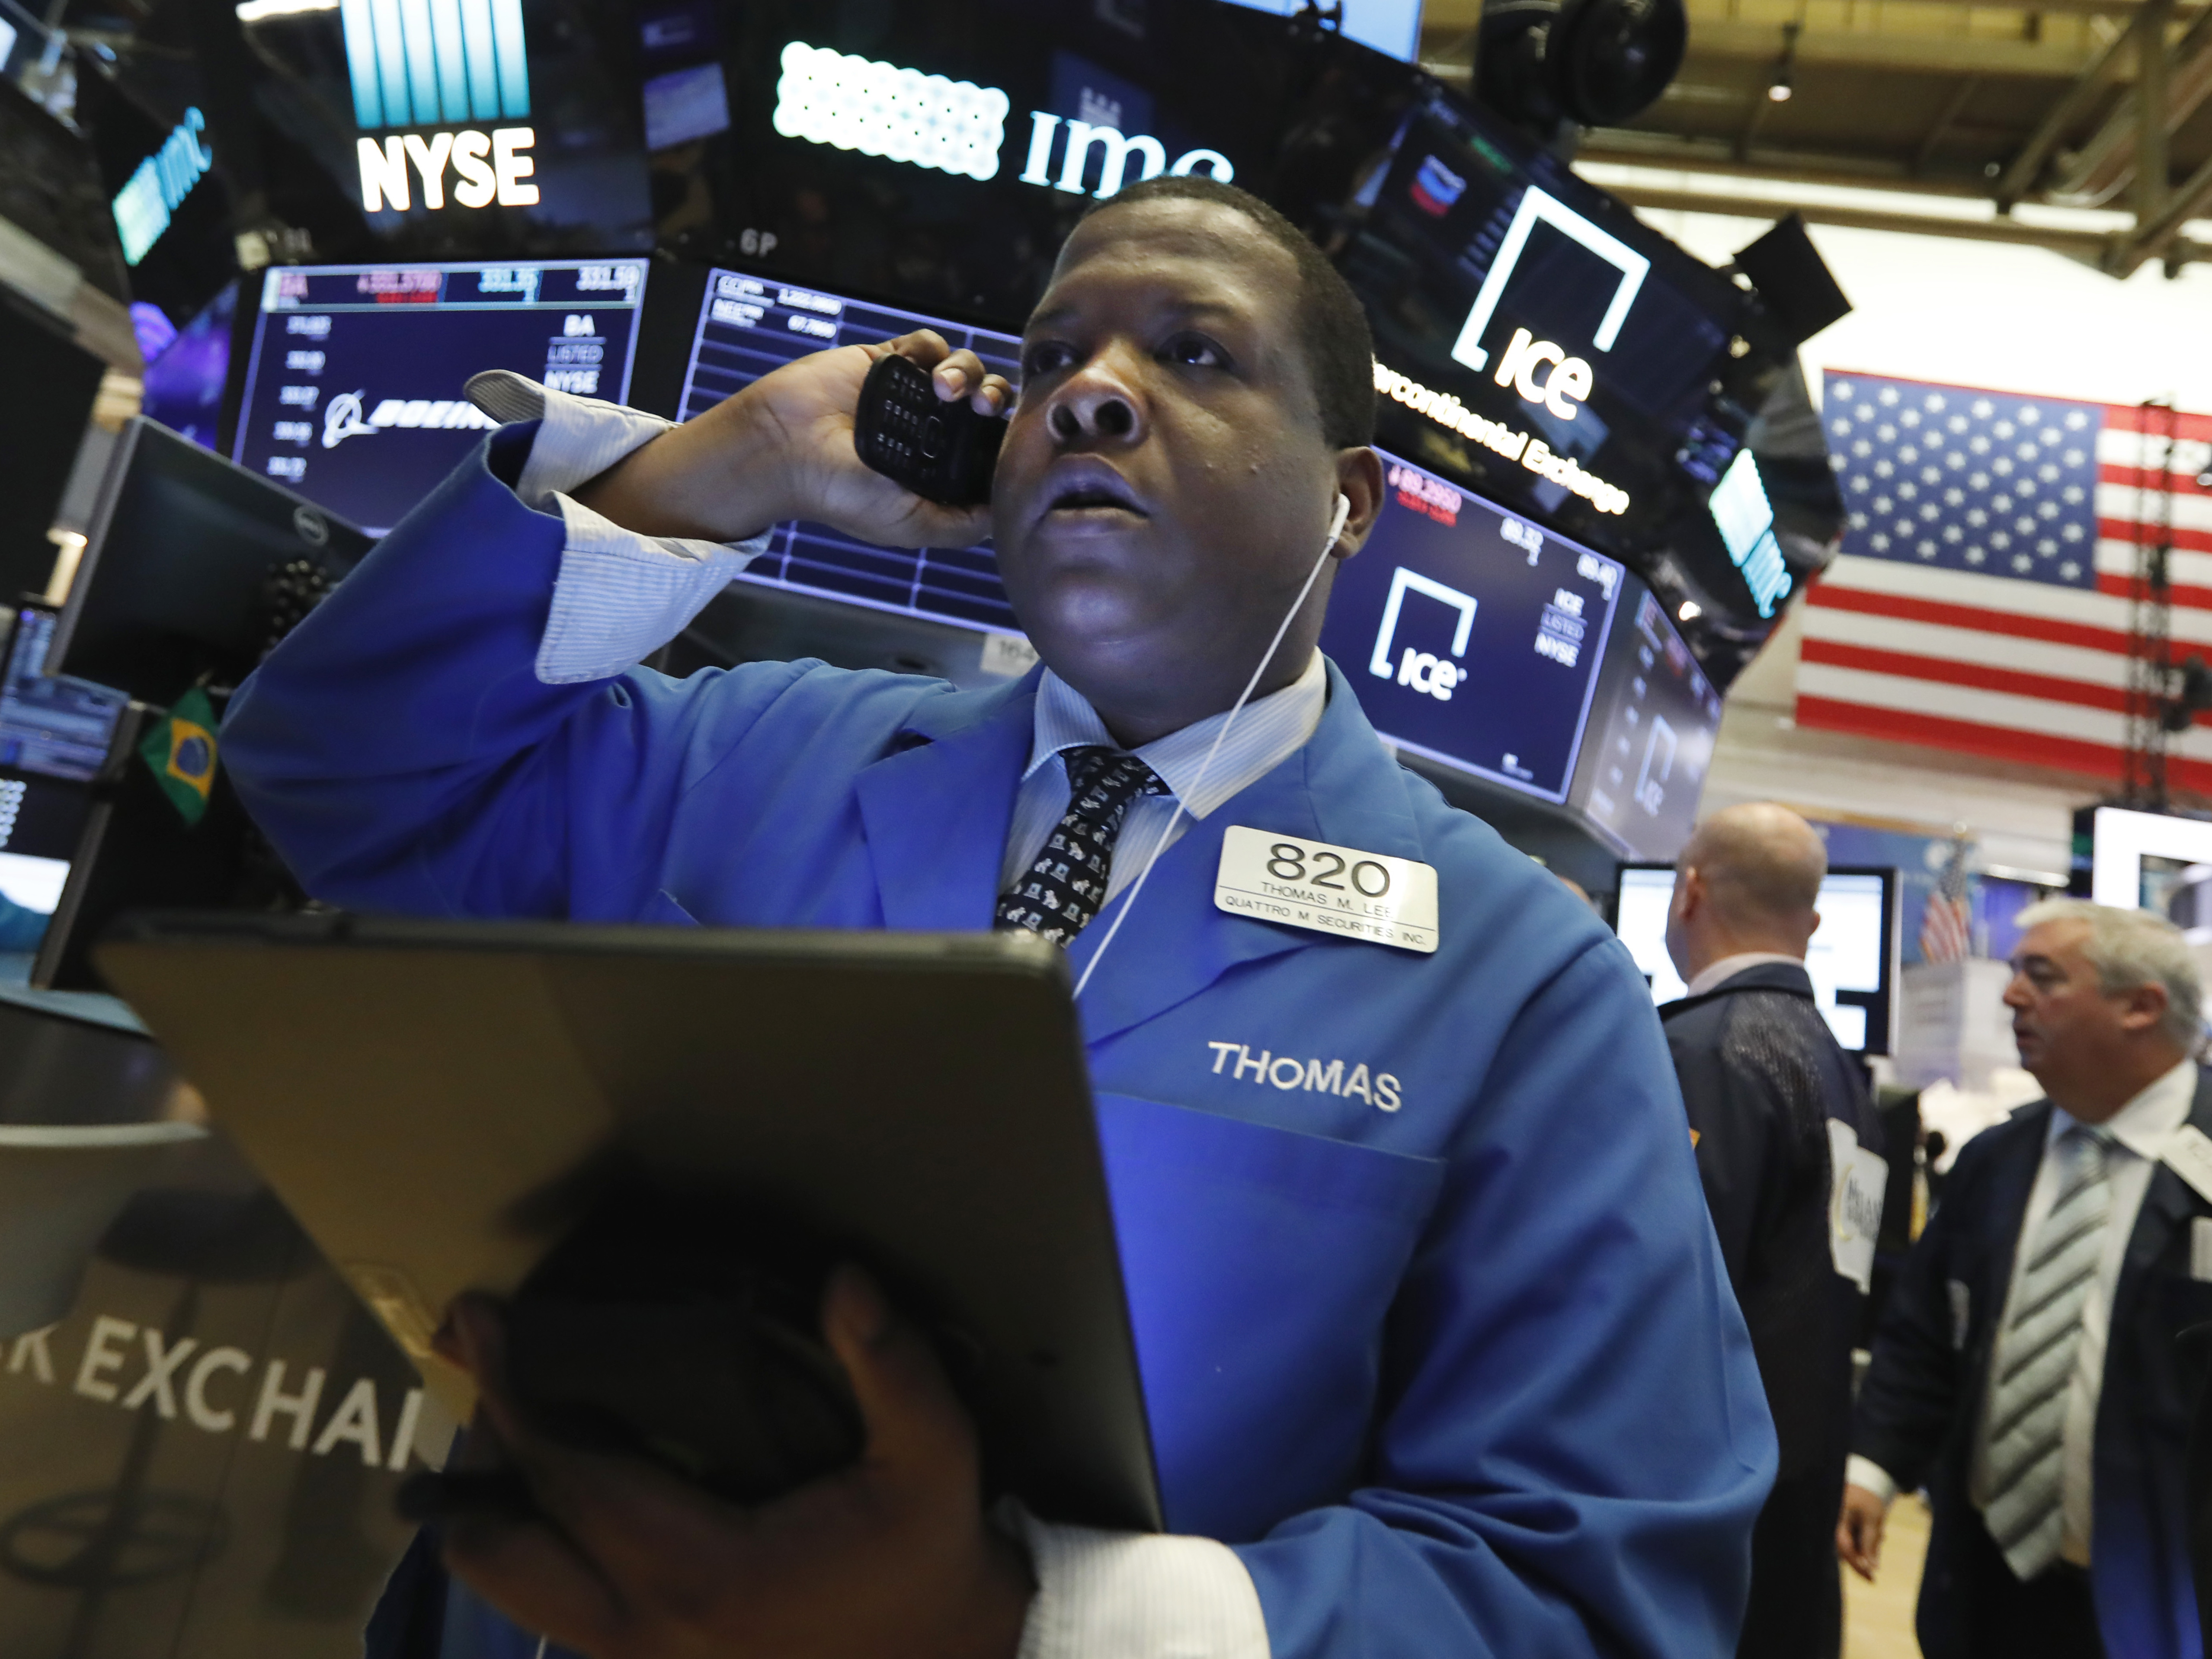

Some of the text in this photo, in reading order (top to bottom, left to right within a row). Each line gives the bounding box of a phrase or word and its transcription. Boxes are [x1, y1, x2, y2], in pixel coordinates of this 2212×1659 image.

[356, 127, 540, 212] NYSE
[563, 314, 595, 337] BA
[547, 344, 604, 364] LISTED
[543, 370, 600, 394] NYSE
[1521, 438, 1630, 516] Exchange
[1553, 587, 1585, 617] ICE
[1540, 611, 1585, 642] LISTED
[1534, 632, 1579, 668] NYSE
[1266, 843, 1390, 898] 820
[1261, 881, 1327, 905] THOMAS
[1364, 903, 1393, 919] LEE
[1225, 895, 1427, 946] QUATTRO M SECURITIES INC.
[1208, 1041, 1402, 1112] THOMAS
